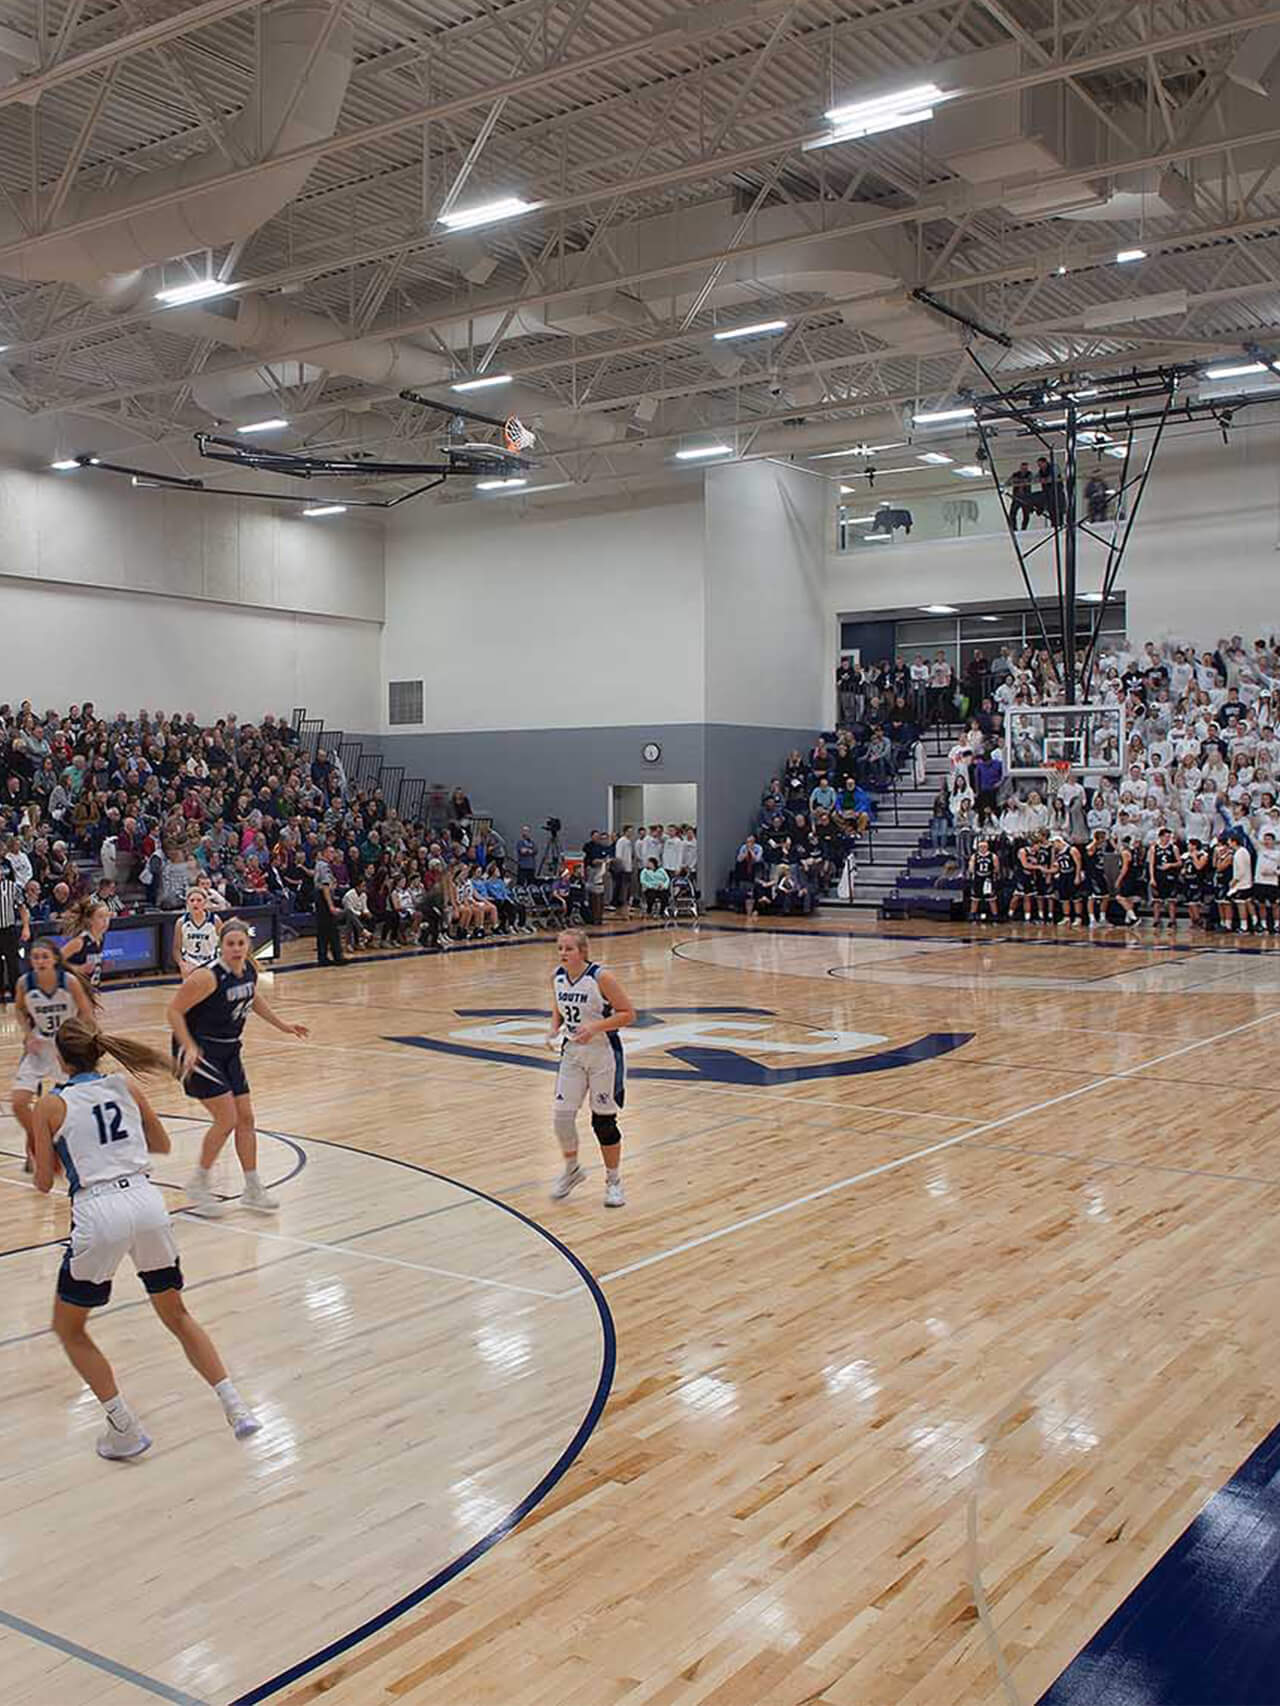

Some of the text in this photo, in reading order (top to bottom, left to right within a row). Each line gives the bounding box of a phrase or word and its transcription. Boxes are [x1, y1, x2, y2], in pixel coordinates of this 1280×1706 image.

[194, 941, 202, 953] 5
[558, 991, 588, 1003] SOUTH
[564, 1005, 581, 1023] 32
[47, 1015, 61, 1029] 31
[91, 1100, 129, 1145] 12
